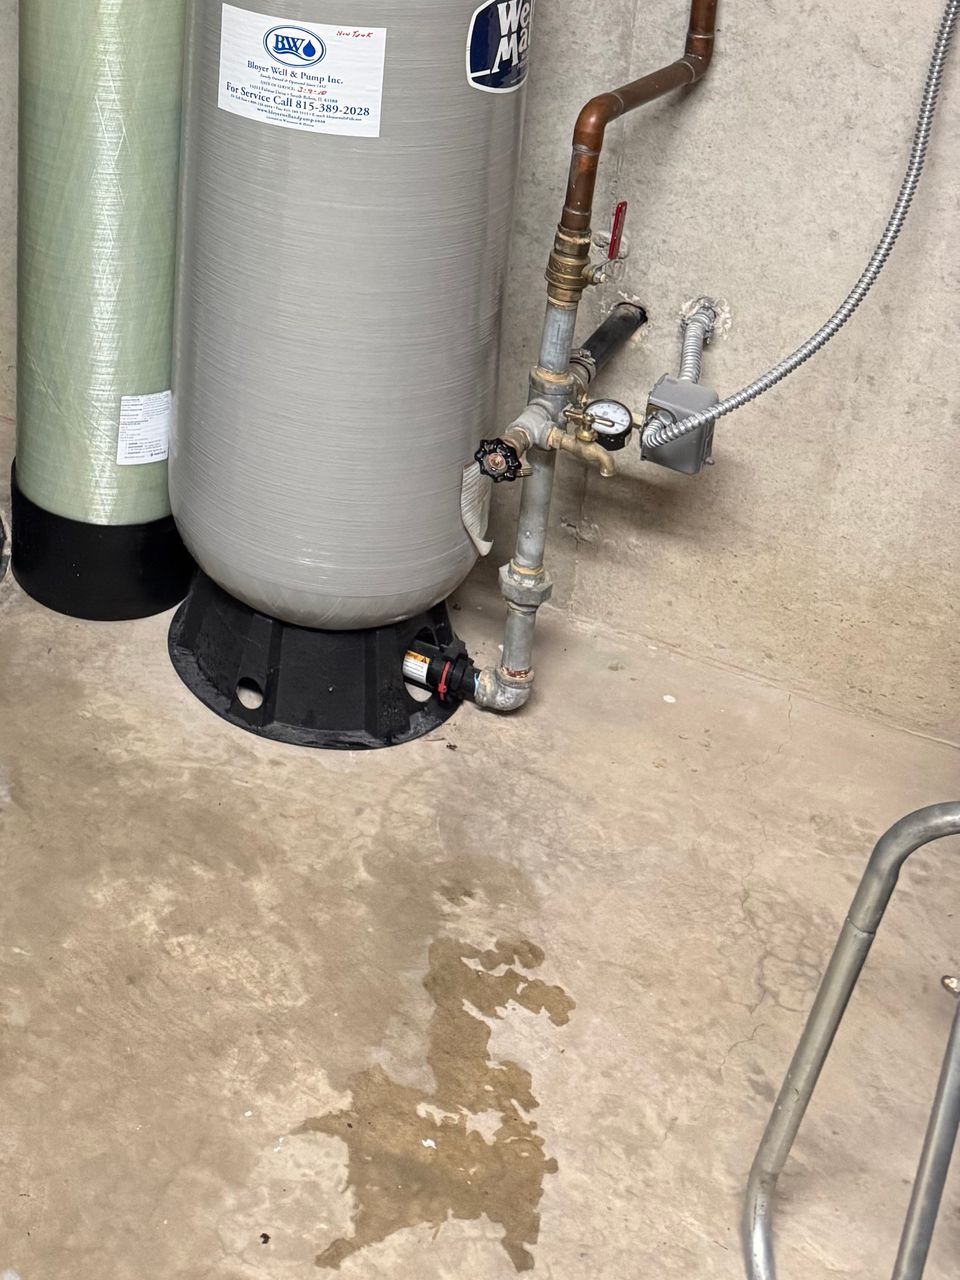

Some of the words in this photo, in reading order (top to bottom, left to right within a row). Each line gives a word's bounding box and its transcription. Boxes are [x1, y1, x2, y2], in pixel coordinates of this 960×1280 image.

[247, 60, 269, 73] Bloyer
[271, 66, 288, 77] Well
[289, 70, 298, 79] &
[300, 71, 325, 84] Pump
[327, 75, 344, 85] Inc.
[226, 81, 239, 94] For
[240, 86, 271, 103] Service
[273, 95, 293, 108] Call
[295, 99, 370, 117] 815-389-2028
